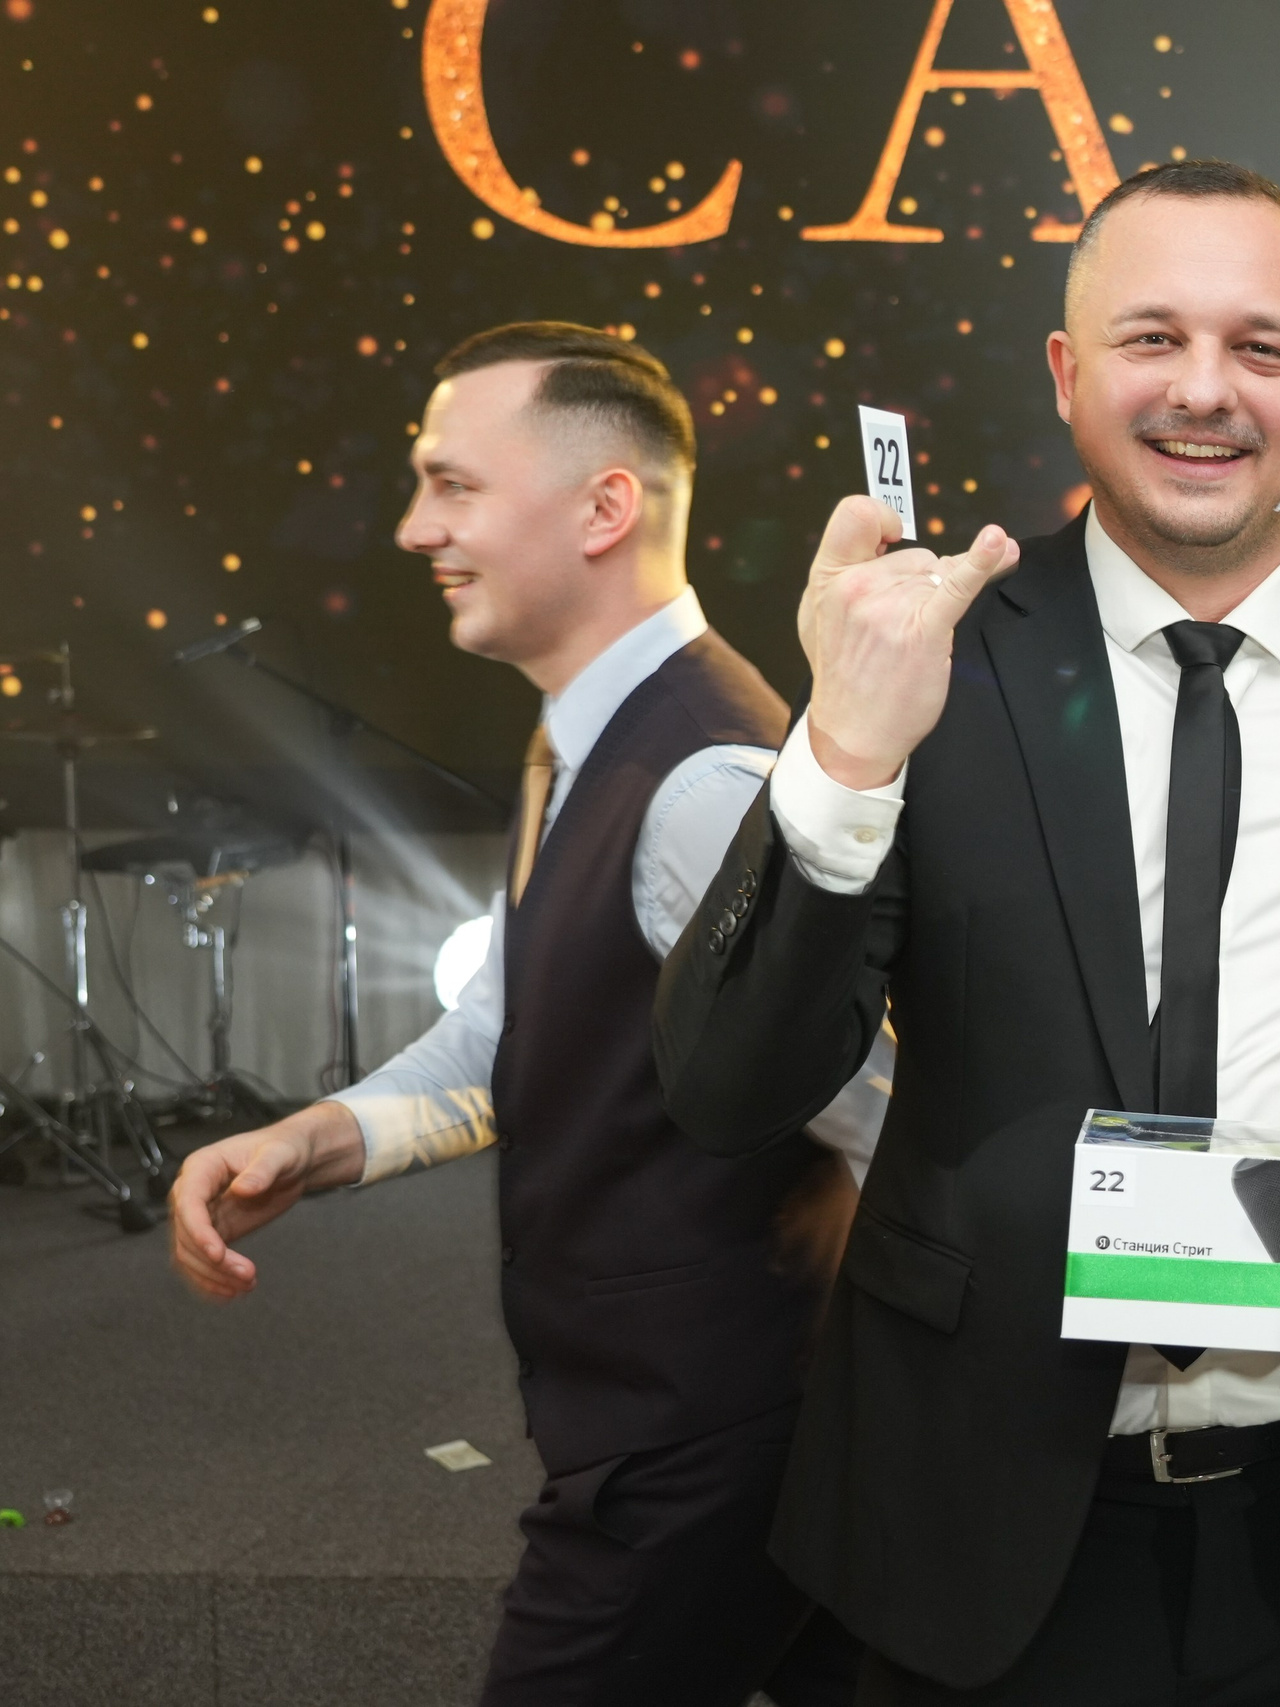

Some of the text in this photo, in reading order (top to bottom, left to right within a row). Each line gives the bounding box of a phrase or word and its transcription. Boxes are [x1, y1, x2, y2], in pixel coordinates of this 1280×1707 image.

[874, 437, 904, 486] 22
[883, 494, 904, 513] 2112
[1089, 1170, 1125, 1192] 22
[1113, 1238, 1169, 1254] Станция
[1173, 1242, 1213, 1257] Стрит
